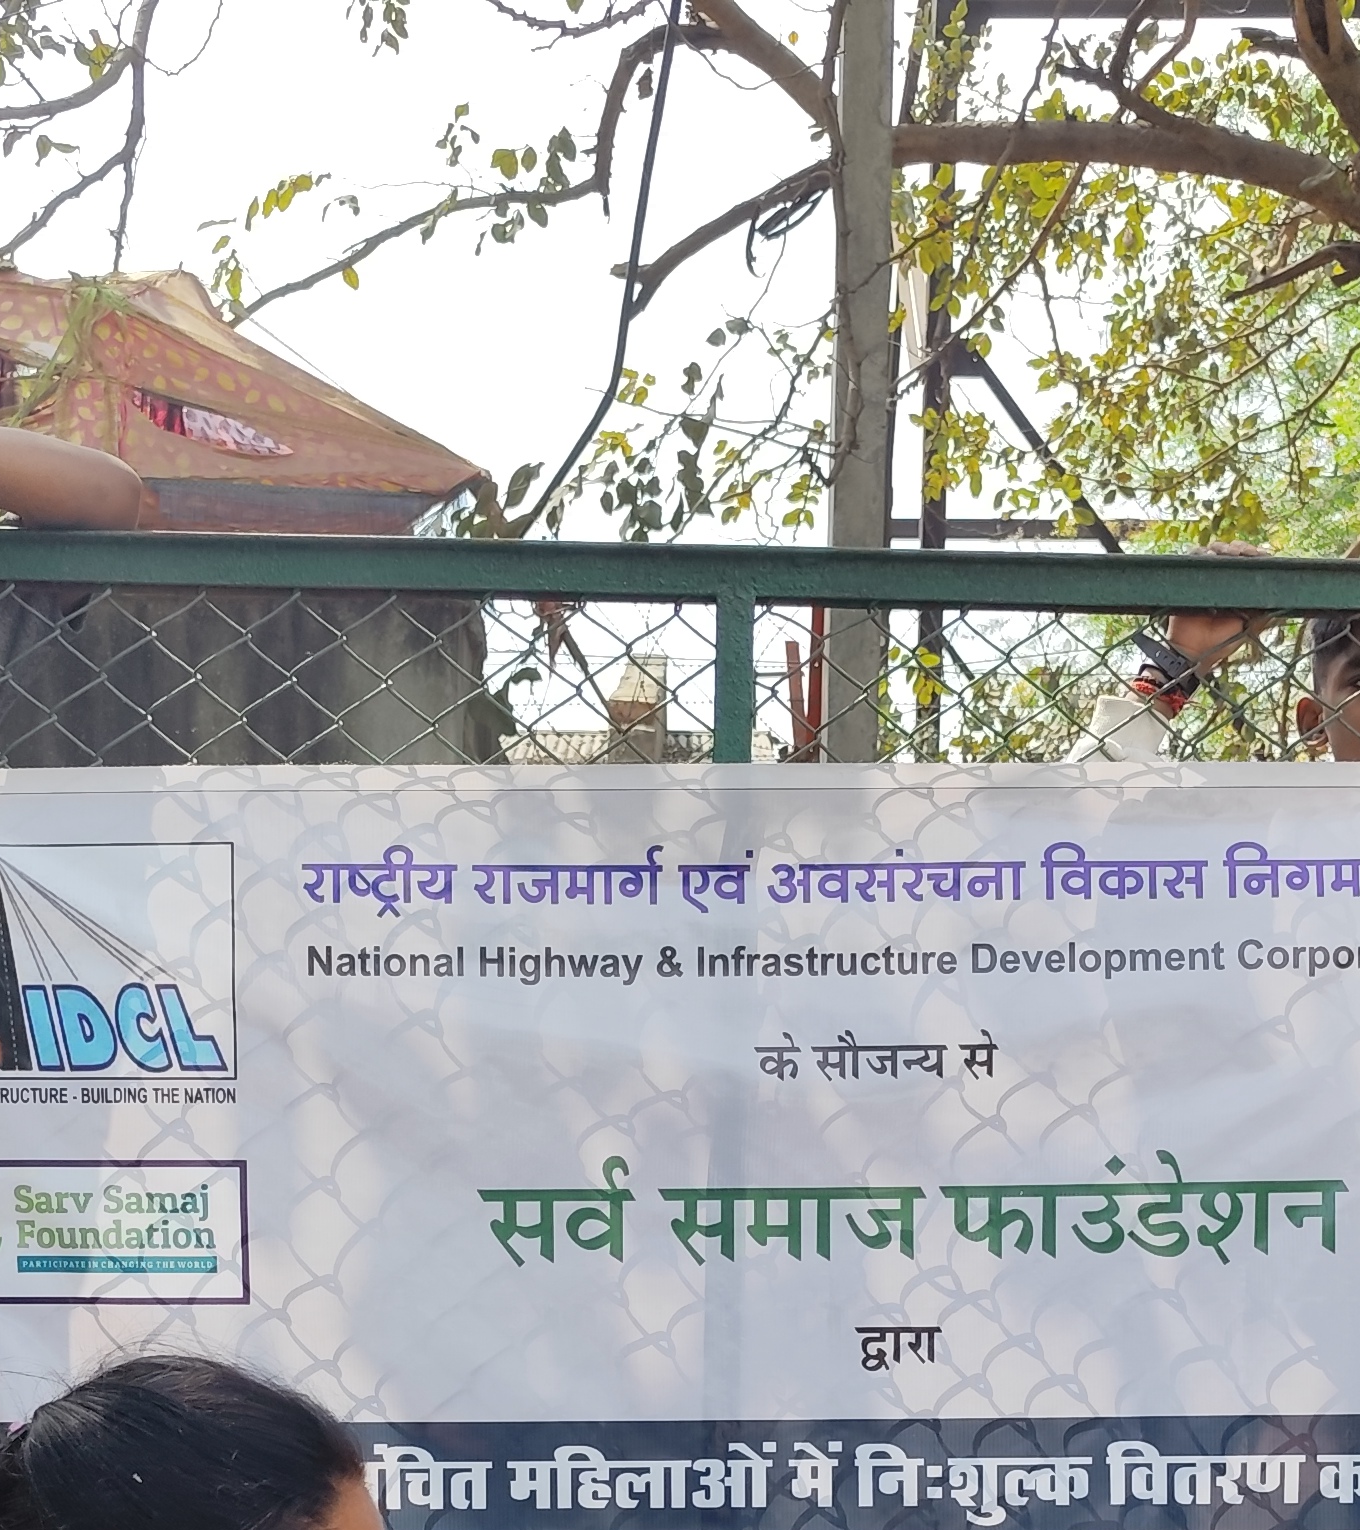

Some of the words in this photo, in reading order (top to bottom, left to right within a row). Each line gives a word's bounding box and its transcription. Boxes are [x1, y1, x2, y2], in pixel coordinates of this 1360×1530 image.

[302, 845, 455, 916] राष्ट्रीय
[473, 845, 661, 906] राजमार्ग
[679, 850, 754, 912] एवं
[768, 848, 1025, 907] अवसंरचना
[1041, 841, 1208, 903] विकास
[308, 946, 464, 979] National
[479, 947, 641, 985] Highway
[656, 947, 683, 978] &
[696, 945, 958, 978] Infrastructure
[971, 942, 1225, 979] Development
[754, 1031, 800, 1081] के
[812, 1029, 948, 1081] सौजन्य
[958, 1029, 998, 1079] से
[81, 1087, 150, 1105] BUILDING
[153, 1087, 180, 1105] THE
[183, 1087, 236, 1105] NATION
[13, 1184, 93, 1214] Sarv
[103, 1183, 209, 1222] Samaj
[477, 1155, 636, 1267] सर्व
[658, 1185, 926, 1262] समाज
[940, 1149, 1349, 1265] फाउंडेशन
[16, 1220, 216, 1249] Foundation
[22, 1260, 86, 1269] PARTICIPATE
[88, 1260, 99, 1269] IN
[101, 1260, 153, 1269] CHANGING
[155, 1260, 175, 1269] THE
[177, 1260, 213, 1269] WORLD
[855, 1324, 942, 1371] द्वारा
[509, 1441, 774, 1511] महिलाओं
[791, 1441, 843, 1508] में
[1106, 1440, 1303, 1506] वितरण
